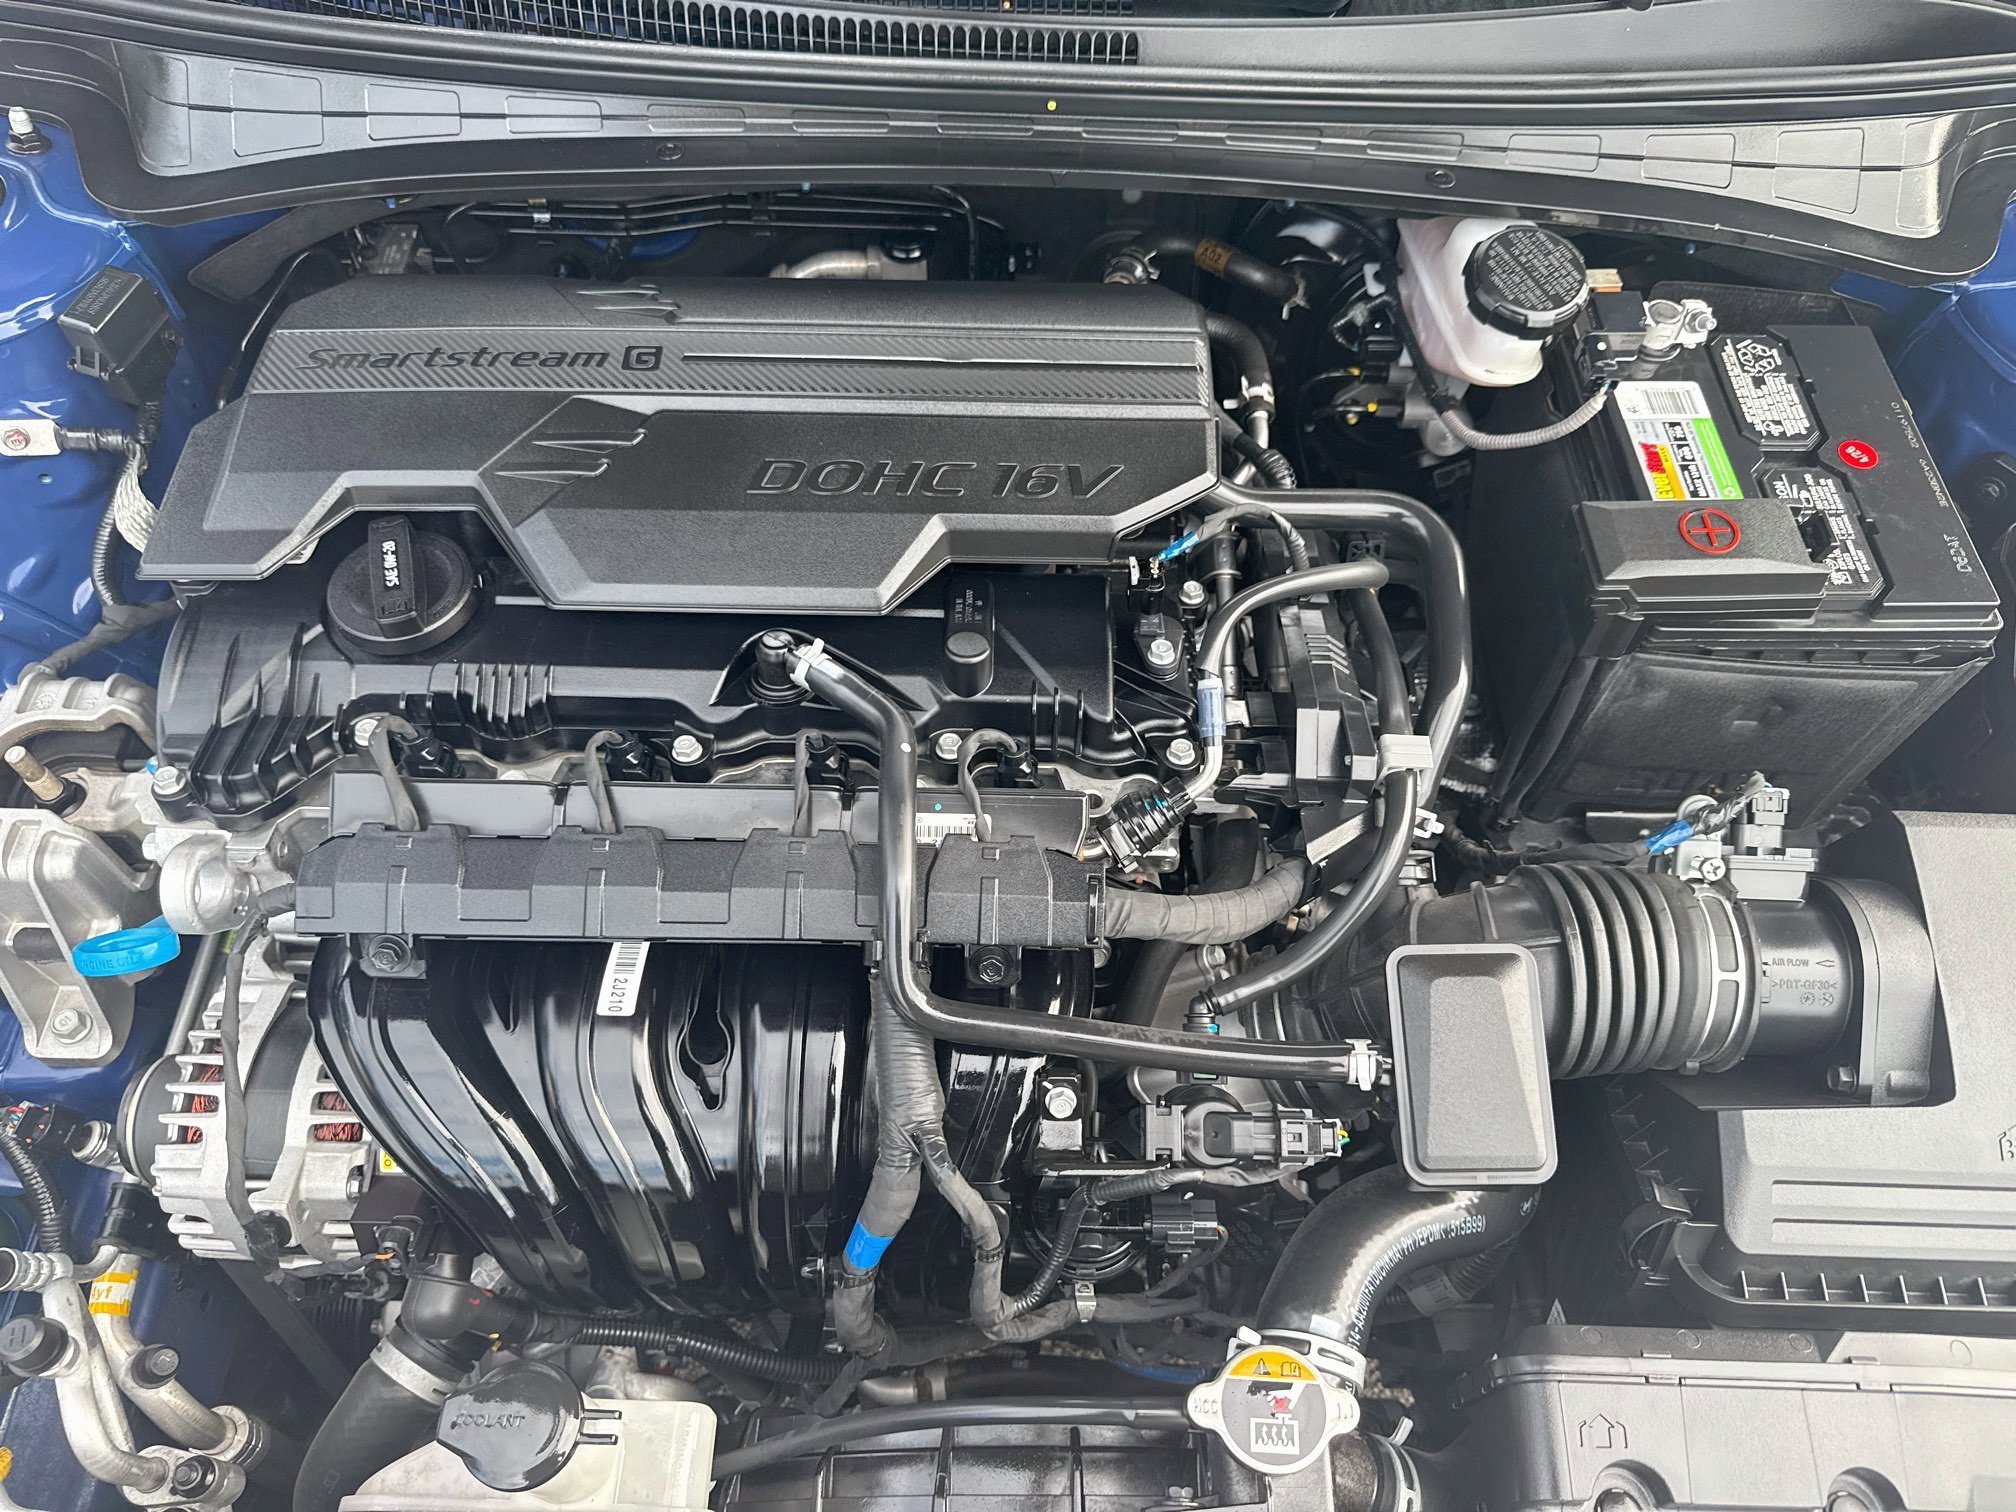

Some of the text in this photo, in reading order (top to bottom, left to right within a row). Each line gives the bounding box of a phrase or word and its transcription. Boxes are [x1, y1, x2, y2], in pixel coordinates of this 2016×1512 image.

[296, 347, 660, 370] Smartstream G
[746, 459, 1125, 499] DOHC 16V
[382, 540, 399, 587] SAE 0W-20
[1772, 958, 1810, 967] AIR FLOW
[608, 978, 629, 1012] 2J210
[1194, 1398, 1219, 1414] HCC
[453, 1412, 526, 1429] COOLANT
